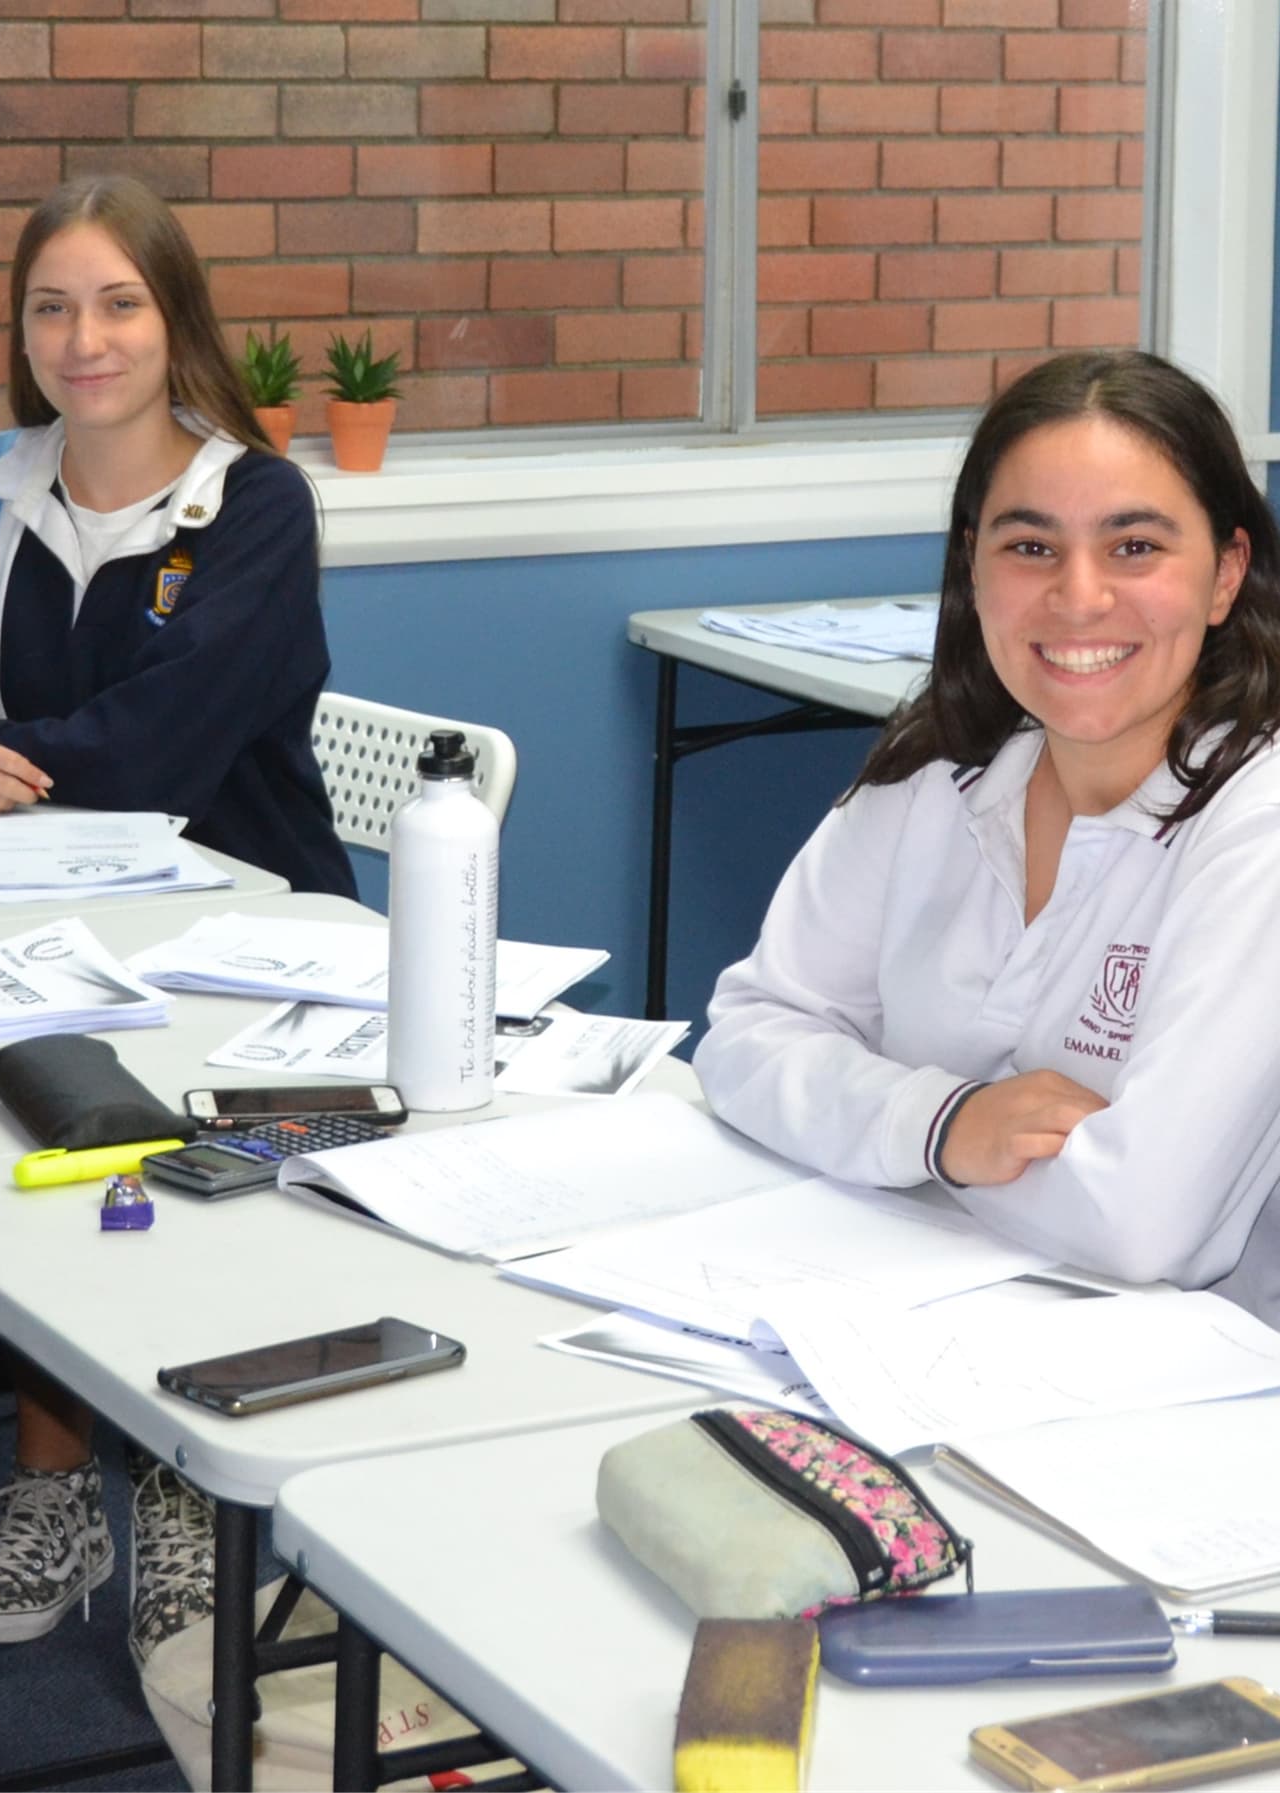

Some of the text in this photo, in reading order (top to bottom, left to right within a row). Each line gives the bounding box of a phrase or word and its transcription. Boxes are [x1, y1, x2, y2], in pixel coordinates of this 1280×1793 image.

[460, 852, 478, 907] bottles
[460, 911, 484, 961] plastic
[459, 965, 476, 1011] about
[459, 1053, 475, 1084] The
[1063, 1036, 1123, 1062] EMANUEL
